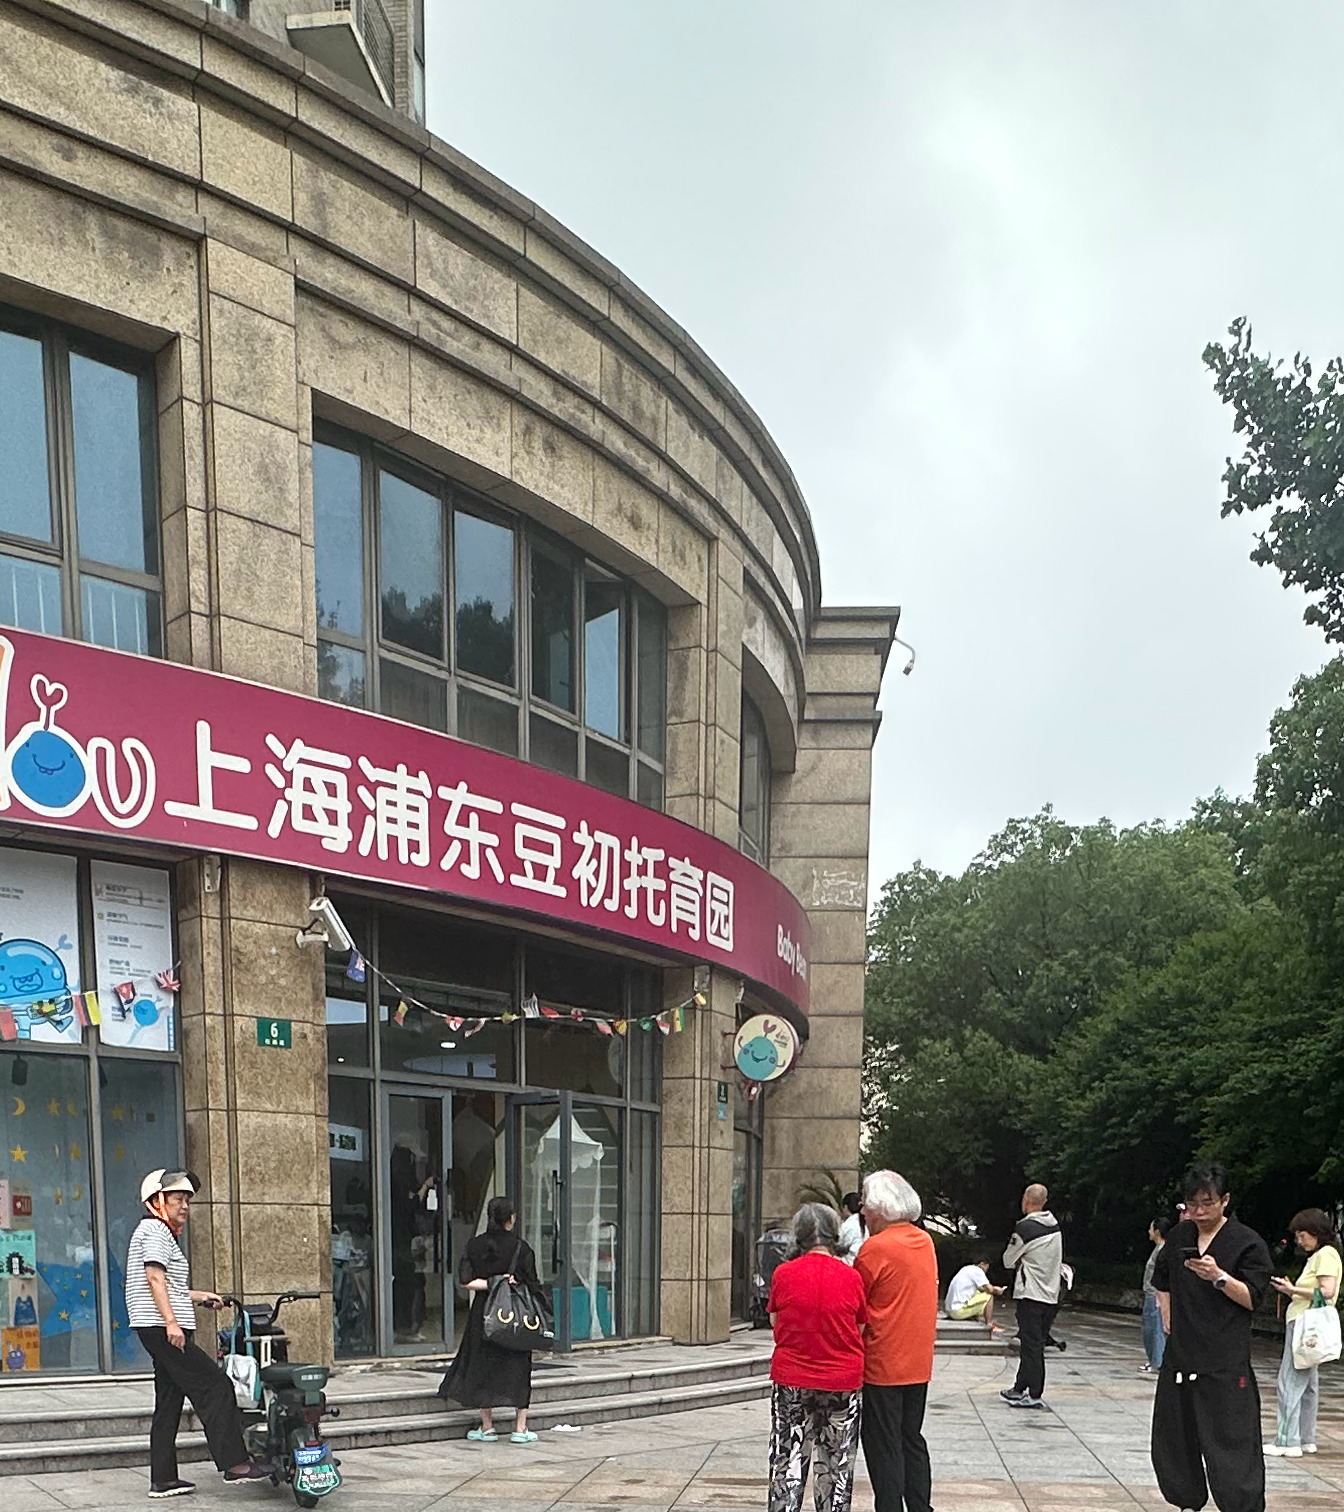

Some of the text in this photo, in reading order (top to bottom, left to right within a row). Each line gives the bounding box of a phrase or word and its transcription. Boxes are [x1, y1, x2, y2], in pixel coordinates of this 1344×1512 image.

[164, 720, 735, 952] 上海浦东豆初托育园
[777, 923, 796, 976] Baby
[270, 1022, 279, 1038] 6
